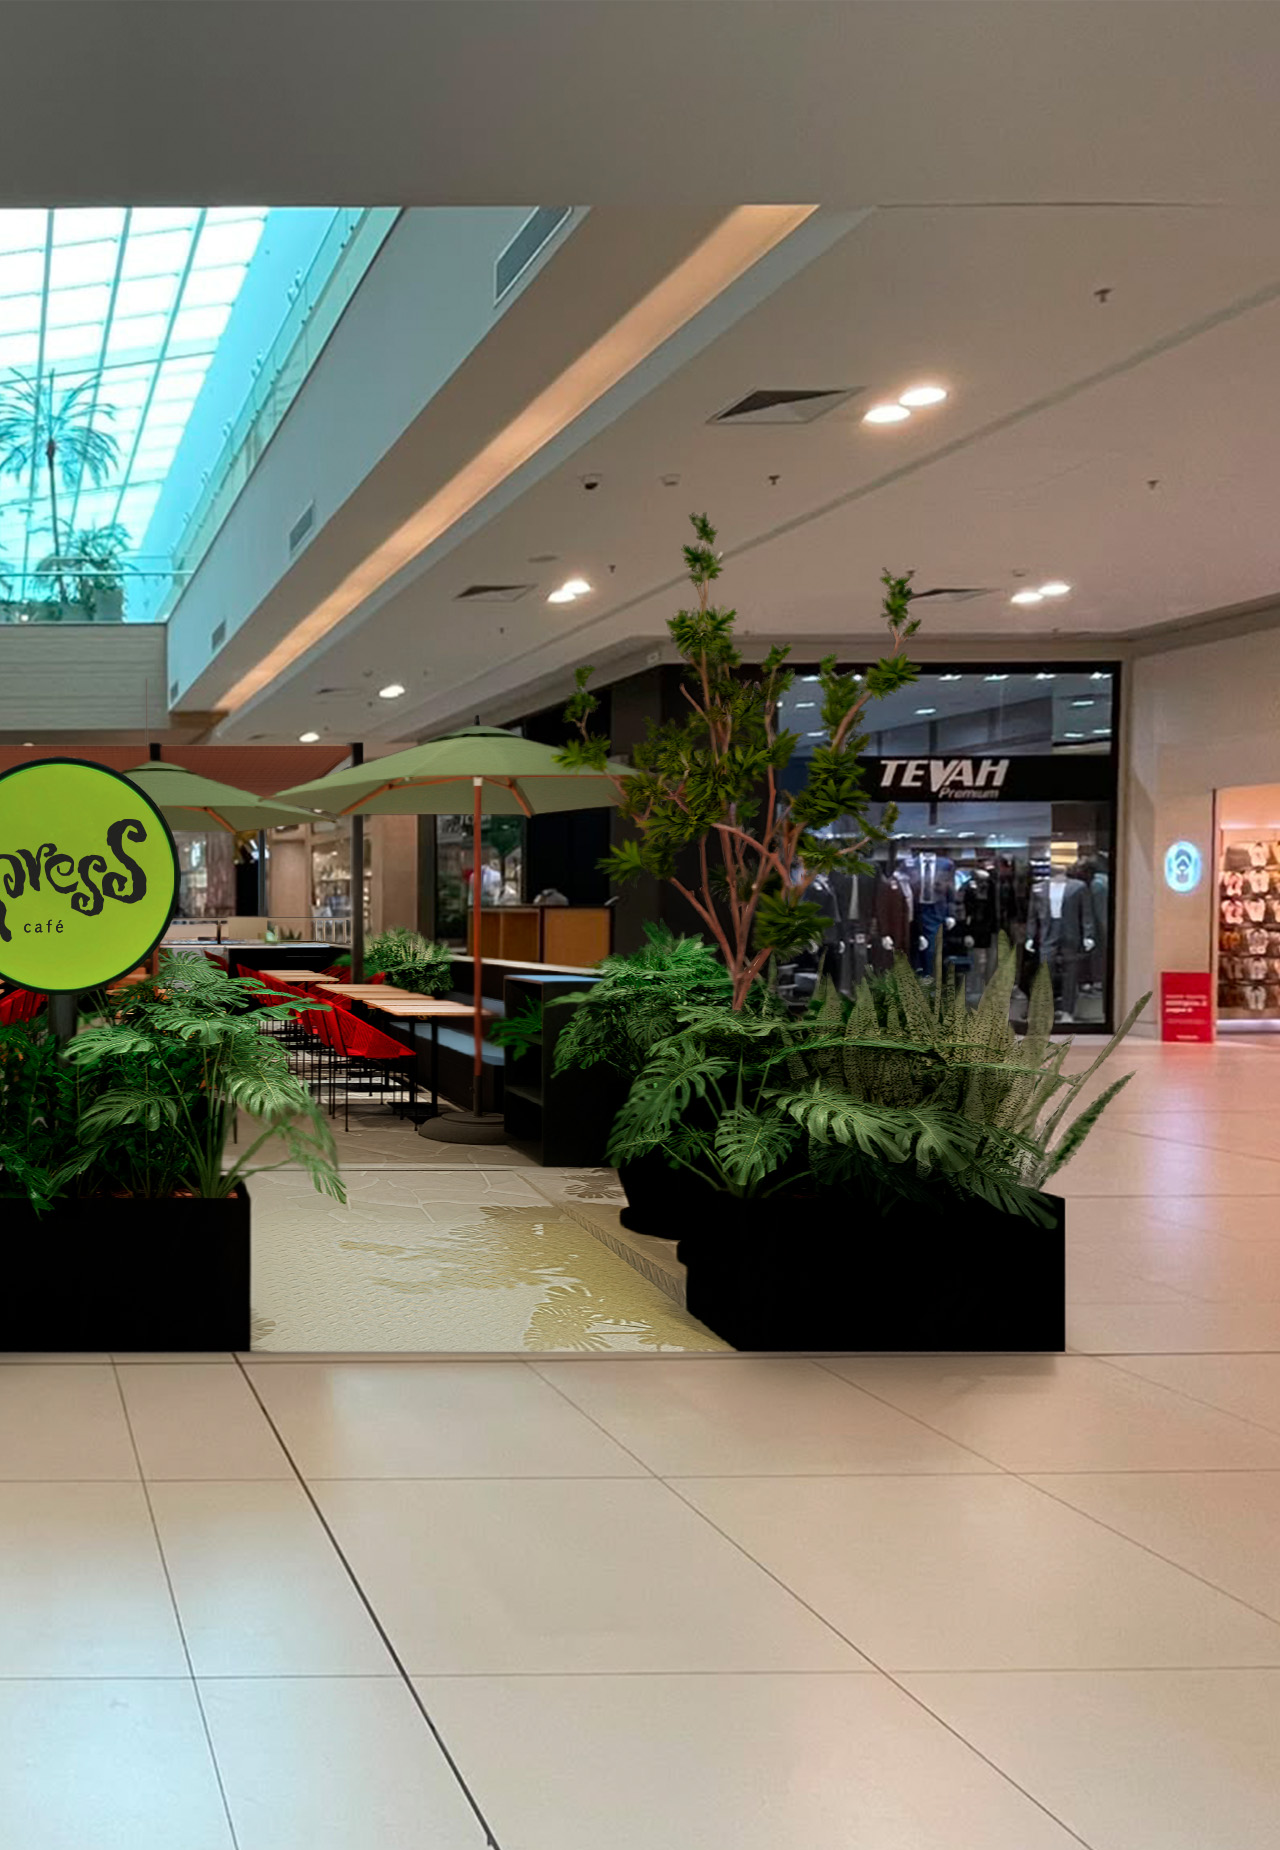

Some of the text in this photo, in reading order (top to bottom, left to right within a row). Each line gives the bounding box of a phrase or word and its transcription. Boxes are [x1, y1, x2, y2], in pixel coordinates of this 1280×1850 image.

[880, 758, 1010, 792] TEVAH
[938, 787, 1000, 799] Premium
[23, 919, 64, 934] café
